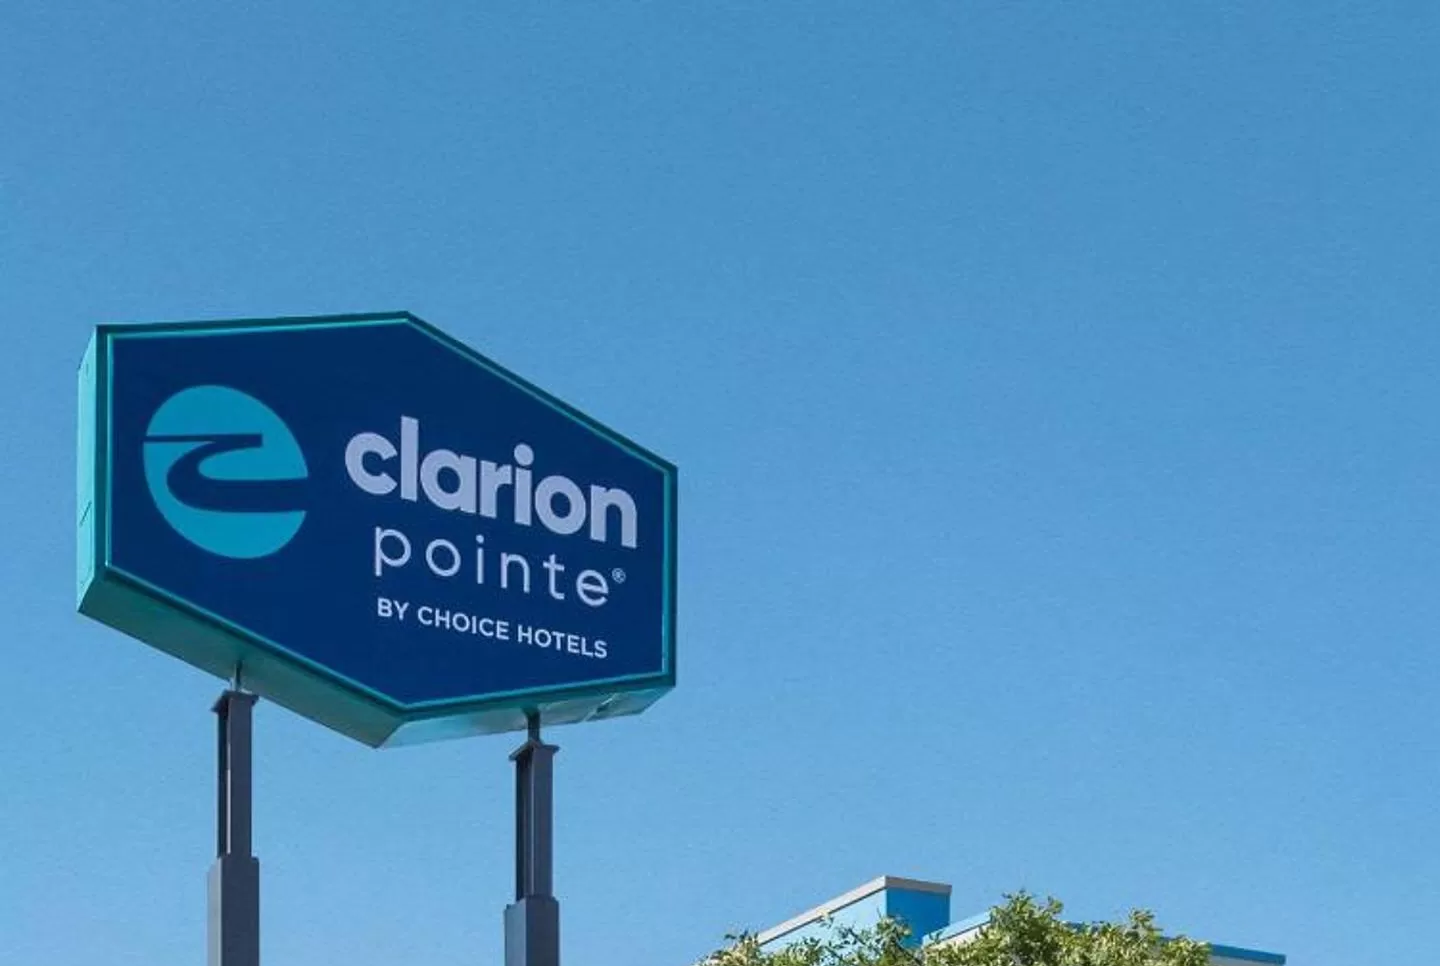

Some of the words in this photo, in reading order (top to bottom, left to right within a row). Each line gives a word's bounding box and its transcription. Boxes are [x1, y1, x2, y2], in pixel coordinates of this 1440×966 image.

[344, 416, 638, 548] clarion
[377, 597, 409, 620] BY
[417, 606, 509, 640] CHOICE
[517, 625, 608, 658] HOTELS
